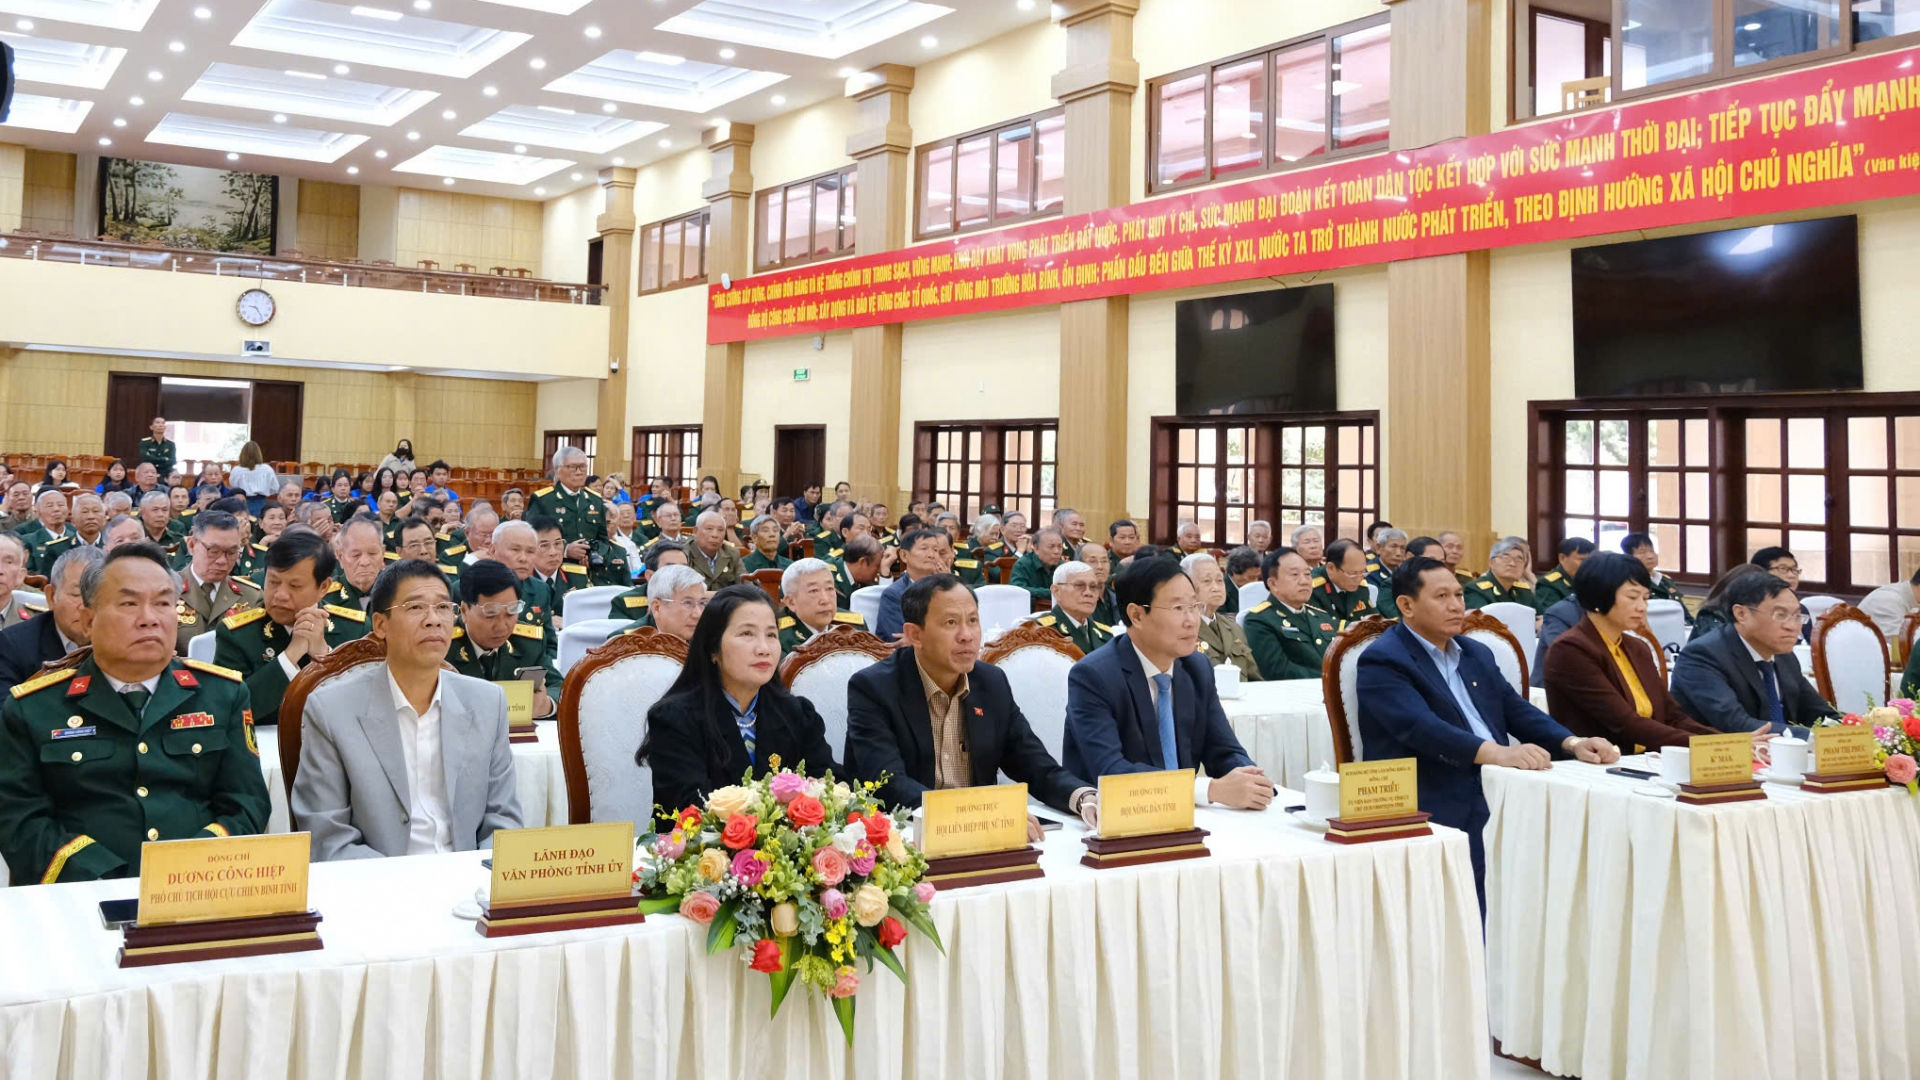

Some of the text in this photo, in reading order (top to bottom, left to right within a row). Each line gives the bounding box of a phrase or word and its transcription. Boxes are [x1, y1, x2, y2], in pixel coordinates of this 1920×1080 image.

[1007, 241, 1027, 262] VỌNG
[1030, 237, 1048, 255] PHÁT
[1052, 229, 1075, 253] TRIỂN
[1076, 227, 1092, 250] ĐẤT
[1095, 223, 1121, 246] NƯỚC,
[1122, 217, 1144, 241] PHÁT
[1149, 216, 1166, 237] HUY
[1170, 209, 1177, 234] Ý
[1179, 205, 1197, 233] CHÍ,
[1201, 205, 1220, 228] SỨC
[1224, 200, 1255, 228] MẠNH
[1258, 196, 1277, 222] ĐẠI
[1315, 179, 1336, 210] KẾT
[1341, 178, 1372, 205] TOÀN
[1377, 172, 1404, 198] DÂN
[1408, 163, 1433, 198] TỘC
[1437, 159, 1461, 189] KẾT
[1502, 148, 1524, 178] VỚI
[1530, 142, 1560, 173] SỨC
[1565, 133, 1615, 169] MẠNH
[1621, 119, 1660, 158] THỜI
[1665, 117, 1702, 153] ĐẠI;
[1709, 101, 1752, 143] TIẾP
[1760, 99, 1797, 139] TỤC
[1804, 80, 1845, 126] ĐẨY
[1854, 75, 1920, 121] MẠNH
[1038, 269, 1061, 290] BÌNH,
[1061, 261, 1075, 288] ỔN
[1075, 262, 1101, 288] ĐỊNH;
[1100, 254, 1127, 282] PHẤN
[1128, 250, 1149, 278] ĐẤU
[1148, 248, 1171, 275] ĐẾN
[1170, 244, 1194, 273] GIỮA
[1196, 239, 1217, 269] THẾ
[1234, 239, 1256, 263] XXI,
[1258, 230, 1291, 260] NƯỚC
[1293, 231, 1308, 255] TA
[1310, 219, 1334, 253] TRỞ
[1337, 217, 1380, 248] THÀNH
[1382, 210, 1418, 243] NƯỚC
[1420, 204, 1456, 238] PHÁT
[1461, 192, 1510, 231] TRIỂN,
[1514, 193, 1554, 224] THEO
[1557, 185, 1599, 222] ĐỊNH
[1603, 173, 1664, 212] HƯỚNG
[1669, 165, 1695, 202] XÃ
[1701, 158, 1734, 201] HỘI
[1740, 148, 1781, 192] CHỦ
[1787, 141, 1864, 186] NGHĨA”
[1865, 157, 1896, 176] (Văn
[1898, 151, 1920, 170] kiệ
[234, 851, 250, 862] CHÍ
[533, 847, 595, 862] LÃNH ĐẠO
[168, 864, 285, 885] DƯƠNG CÔNG HIỆP
[502, 858, 624, 882] VĂN PHÒNG TỈNH ỦY
